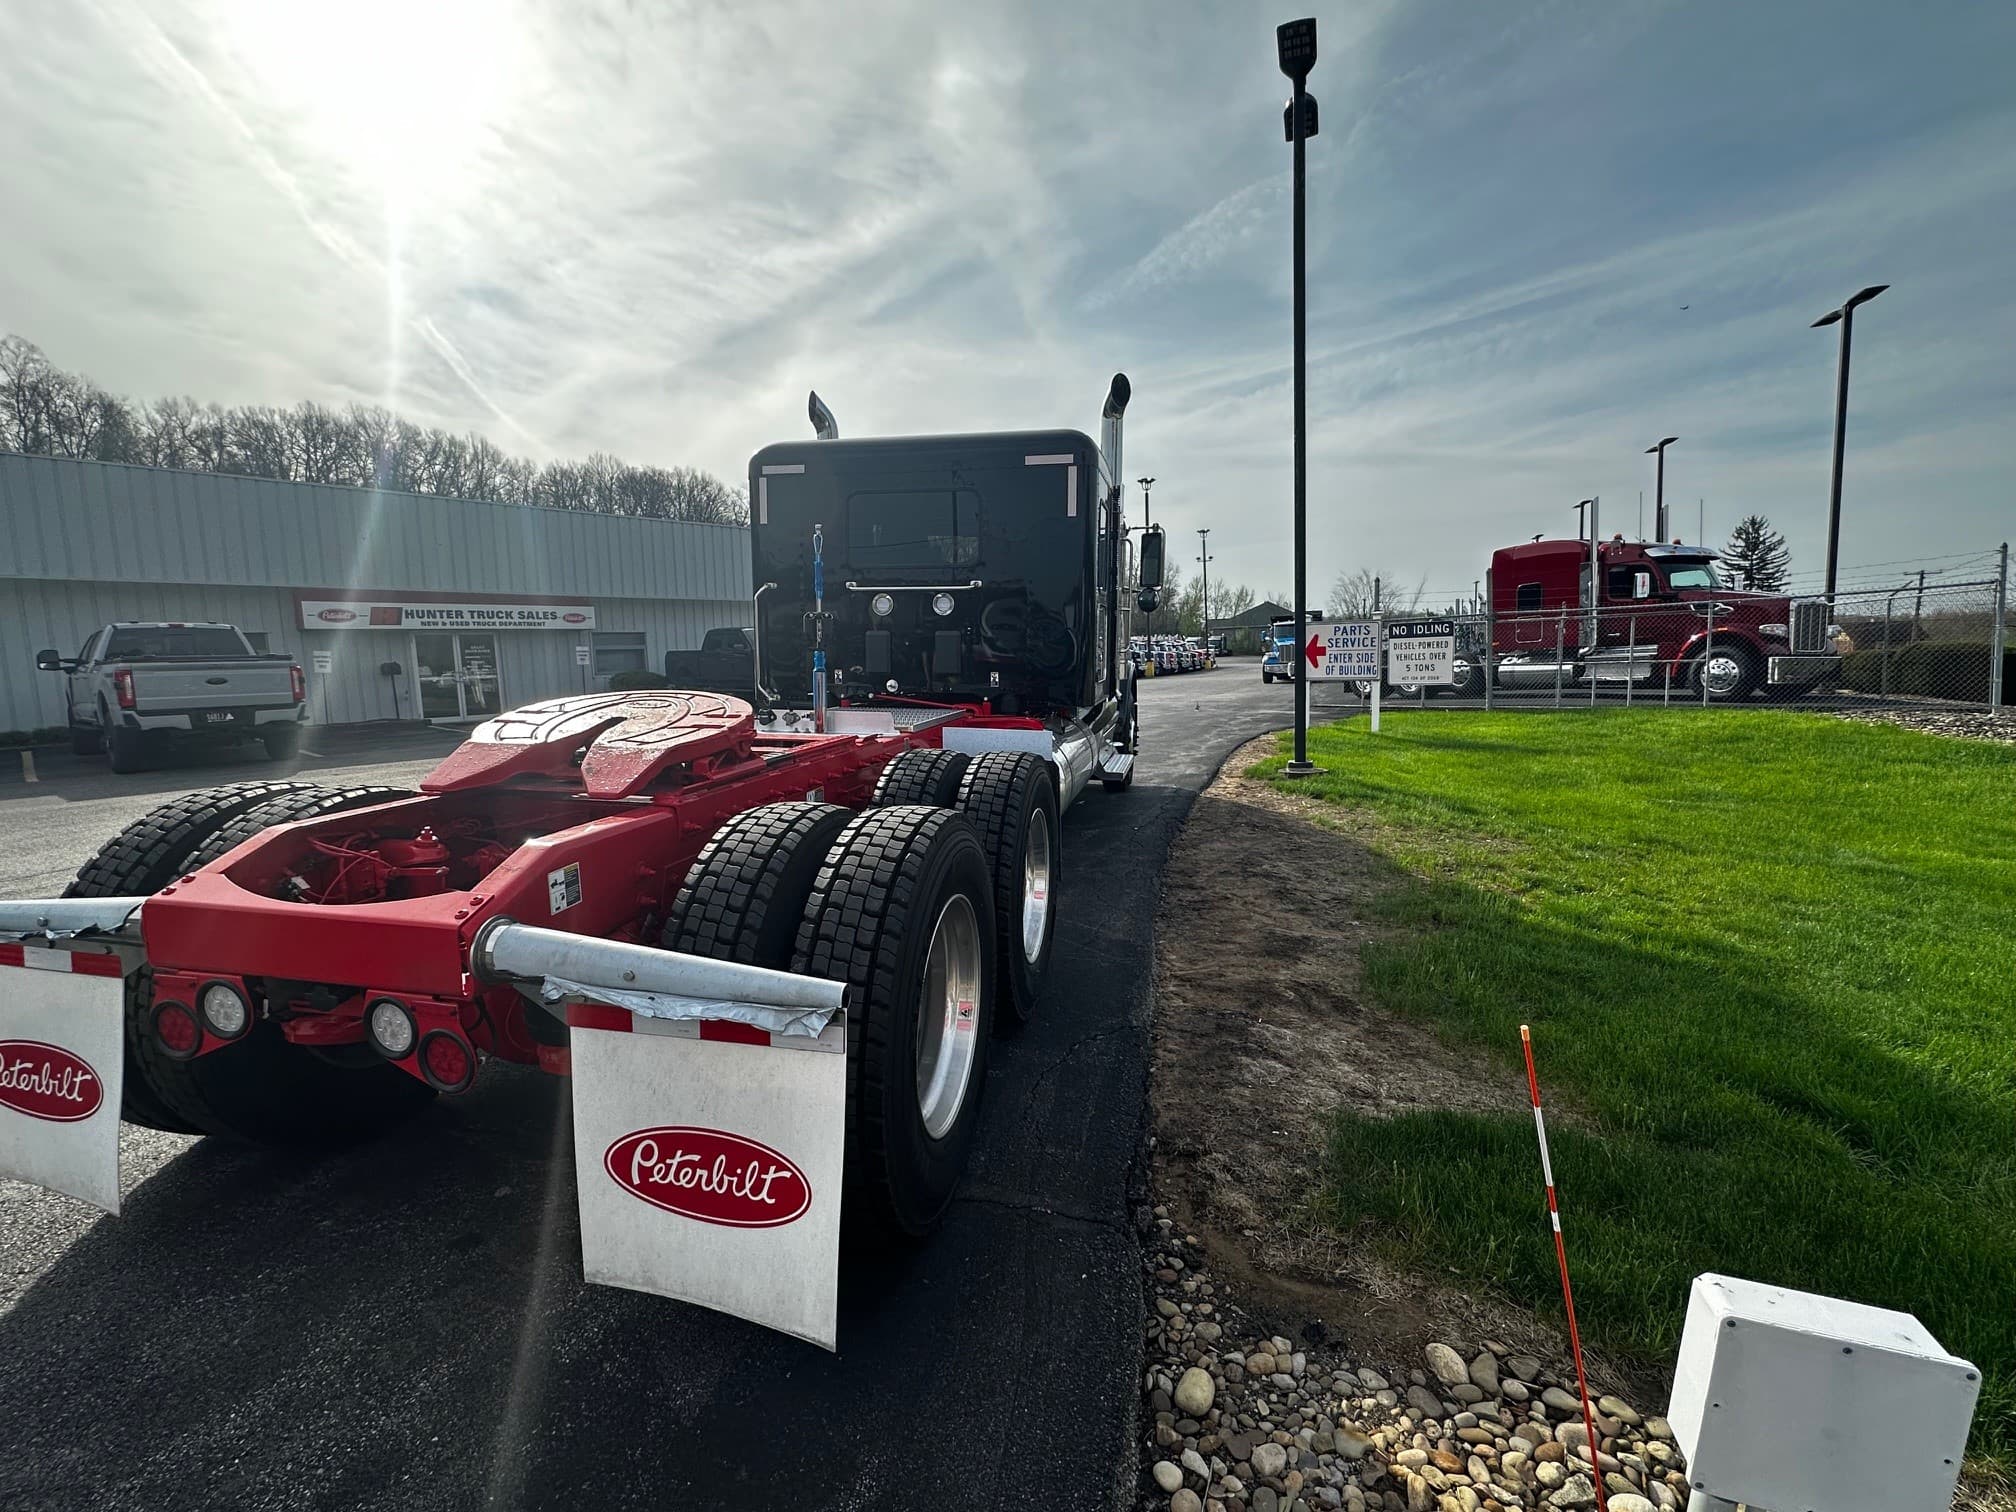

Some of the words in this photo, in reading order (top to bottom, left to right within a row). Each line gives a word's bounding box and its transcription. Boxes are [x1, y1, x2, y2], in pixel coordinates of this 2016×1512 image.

[404, 609, 464, 619] HUNTER
[468, 610, 514, 619] TRUCK
[517, 611, 558, 620] SALES
[1333, 625, 1371, 636] PARTS
[1392, 625, 1407, 635] NO
[1413, 623, 1450, 634] IDLING
[1327, 637, 1377, 648] SERVICE
[1393, 640, 1449, 650] DIESEL-POWERED
[1328, 652, 1353, 664] ENTER
[1356, 652, 1375, 663] SIDE
[1395, 652, 1426, 661] VEHICLES
[1429, 651, 1446, 660] OVER
[1325, 665, 1336, 676] OF
[1339, 664, 1377, 676] BUILDING
[1406, 664, 1411, 672] 5
[1415, 664, 1436, 672] TONS
[631, 1139, 793, 1204] Peterbilt
